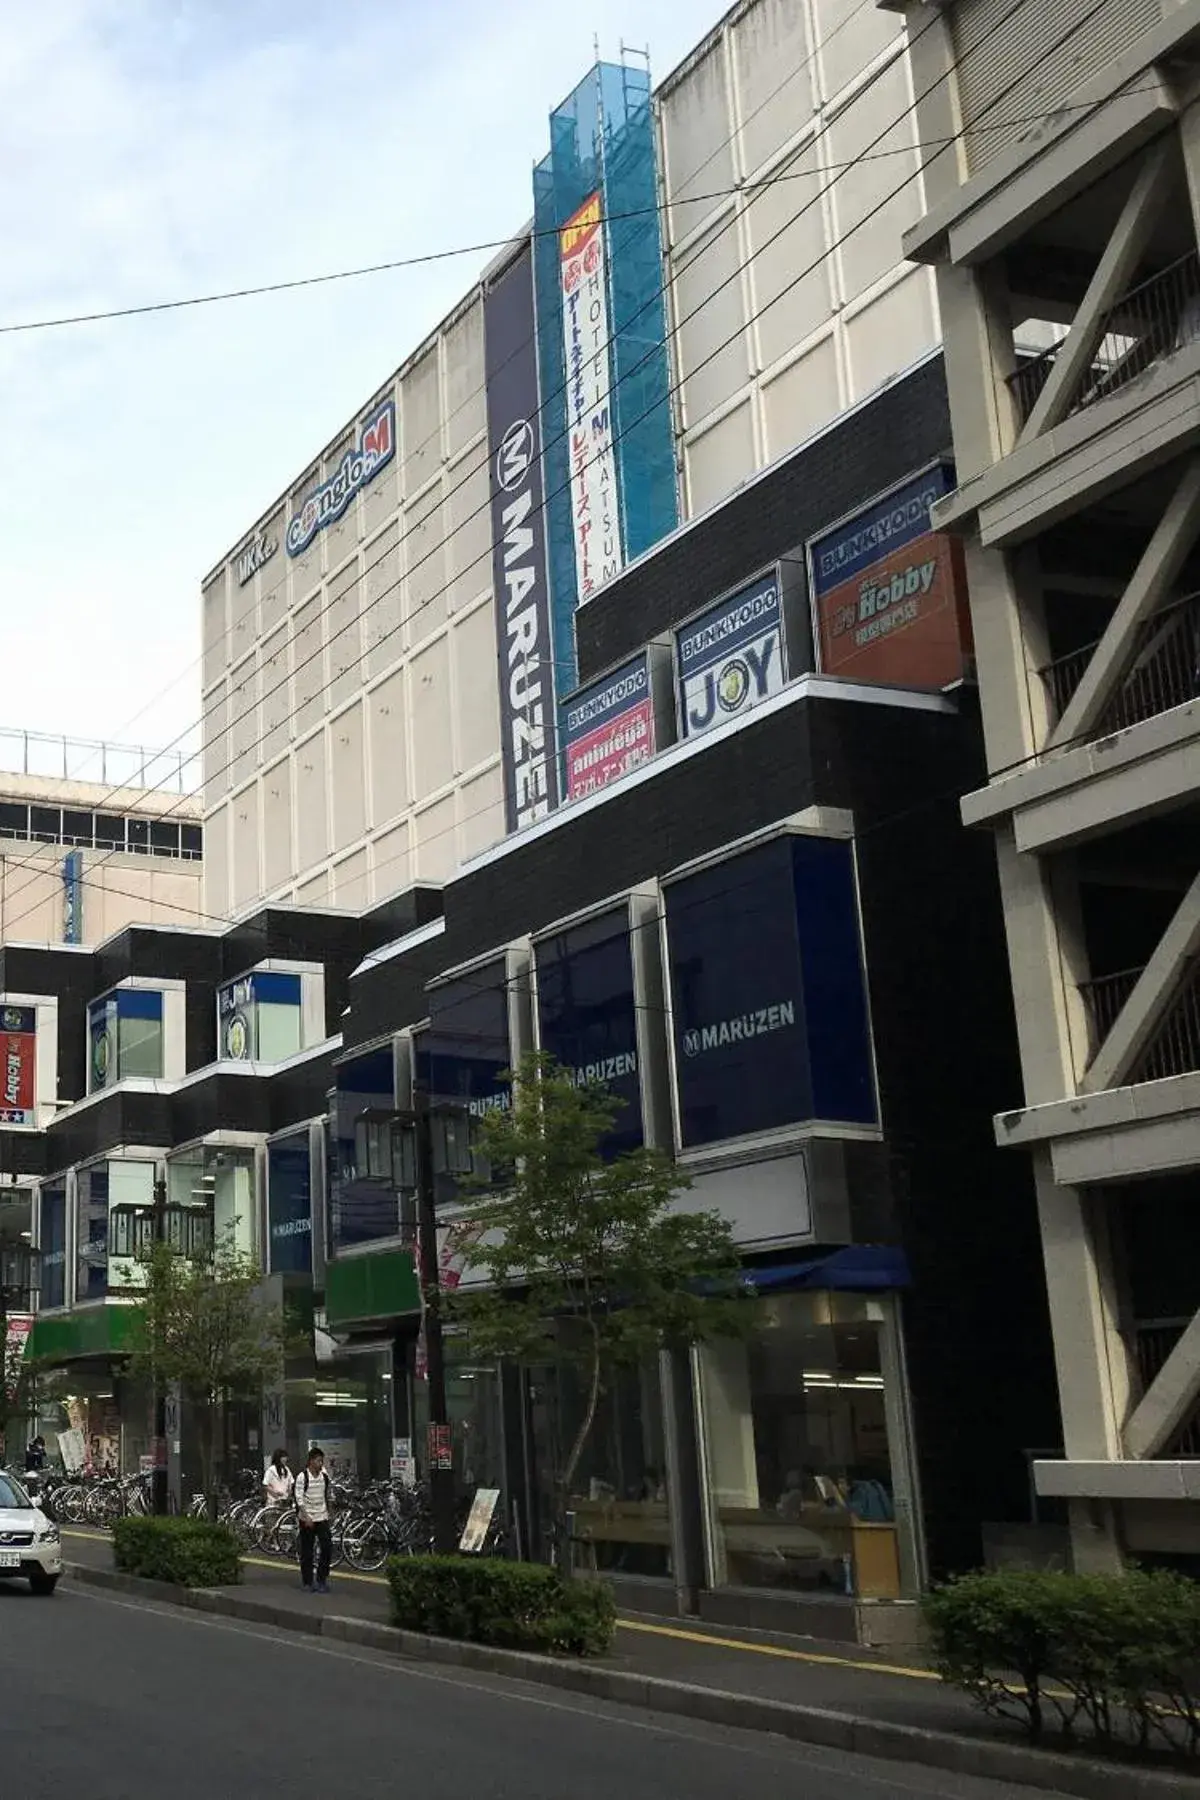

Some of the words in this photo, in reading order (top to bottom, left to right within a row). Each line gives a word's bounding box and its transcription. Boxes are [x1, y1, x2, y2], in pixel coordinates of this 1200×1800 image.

[858, 560, 937, 621] Hobby
[681, 586, 777, 662] BUNKYODO
[568, 667, 646, 731] BUNKYODO
[689, 635, 777, 730] JOY
[702, 1001, 795, 1050] MARUZEN
[5, 1053, 22, 1105] Hobby
